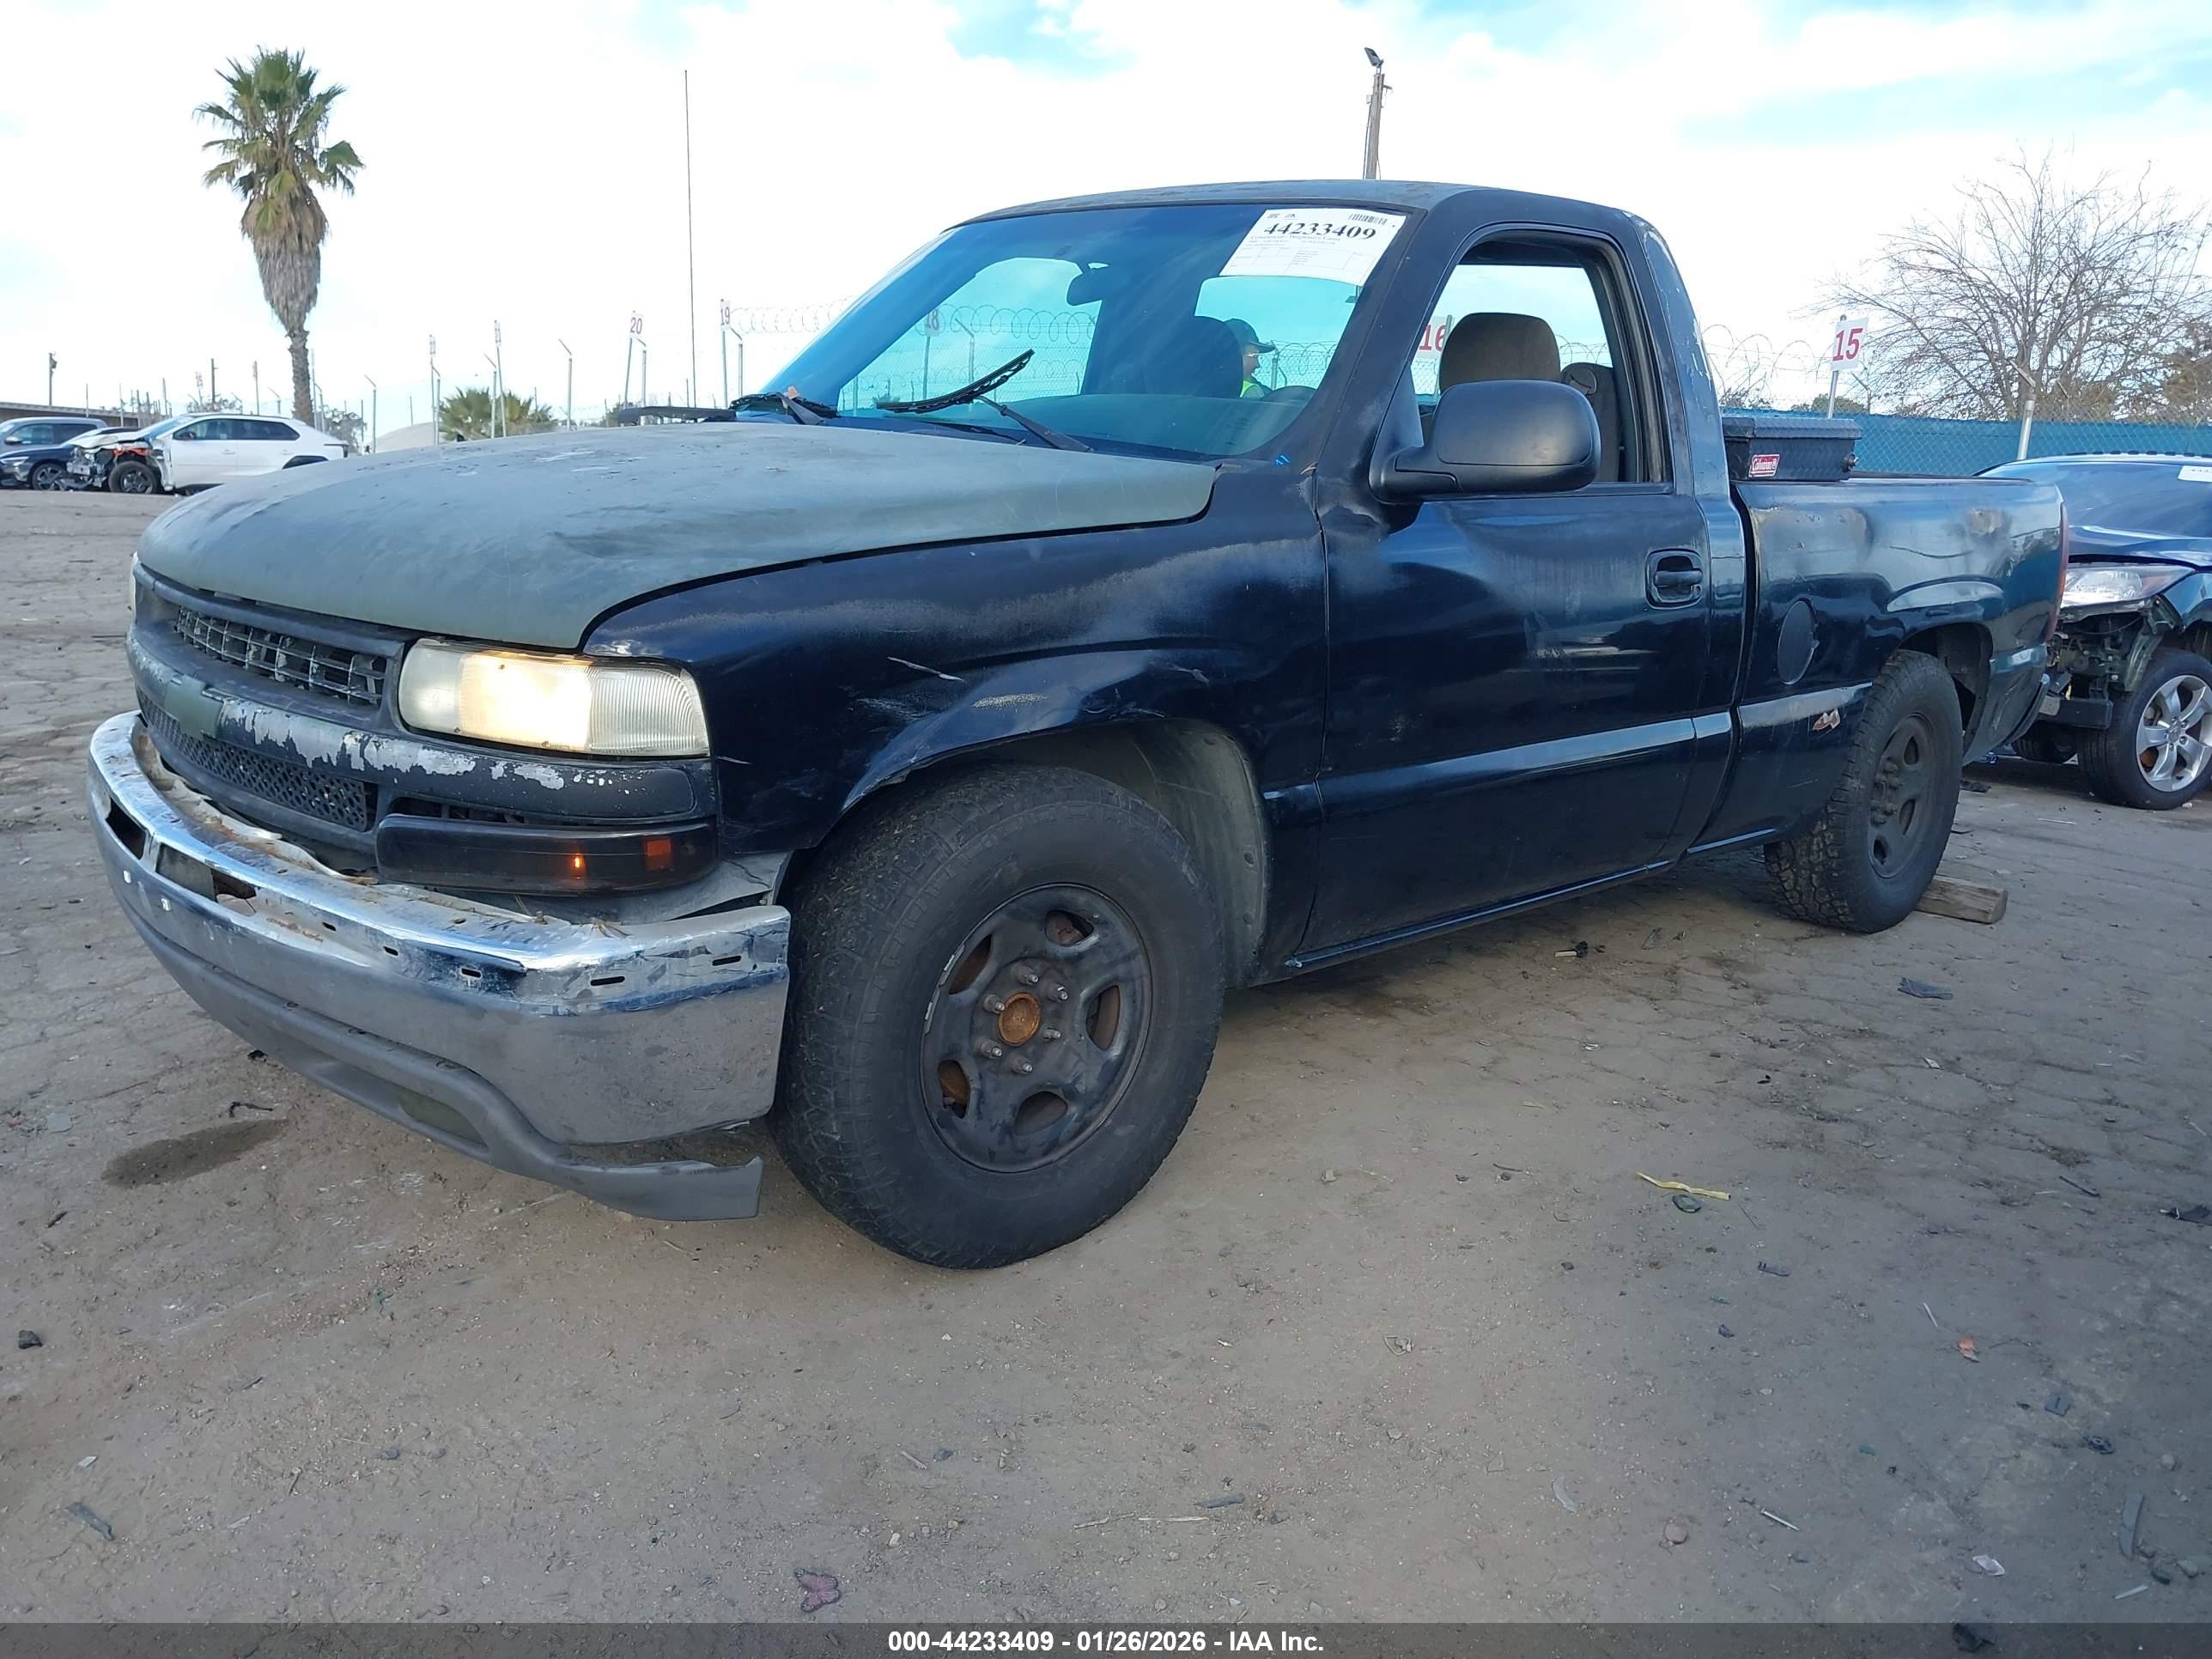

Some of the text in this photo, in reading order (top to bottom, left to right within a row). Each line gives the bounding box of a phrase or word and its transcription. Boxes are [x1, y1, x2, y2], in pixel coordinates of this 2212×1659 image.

[1264, 222, 1376, 240] 44233409
[629, 317, 643, 334] 20
[1832, 328, 1863, 361] 15
